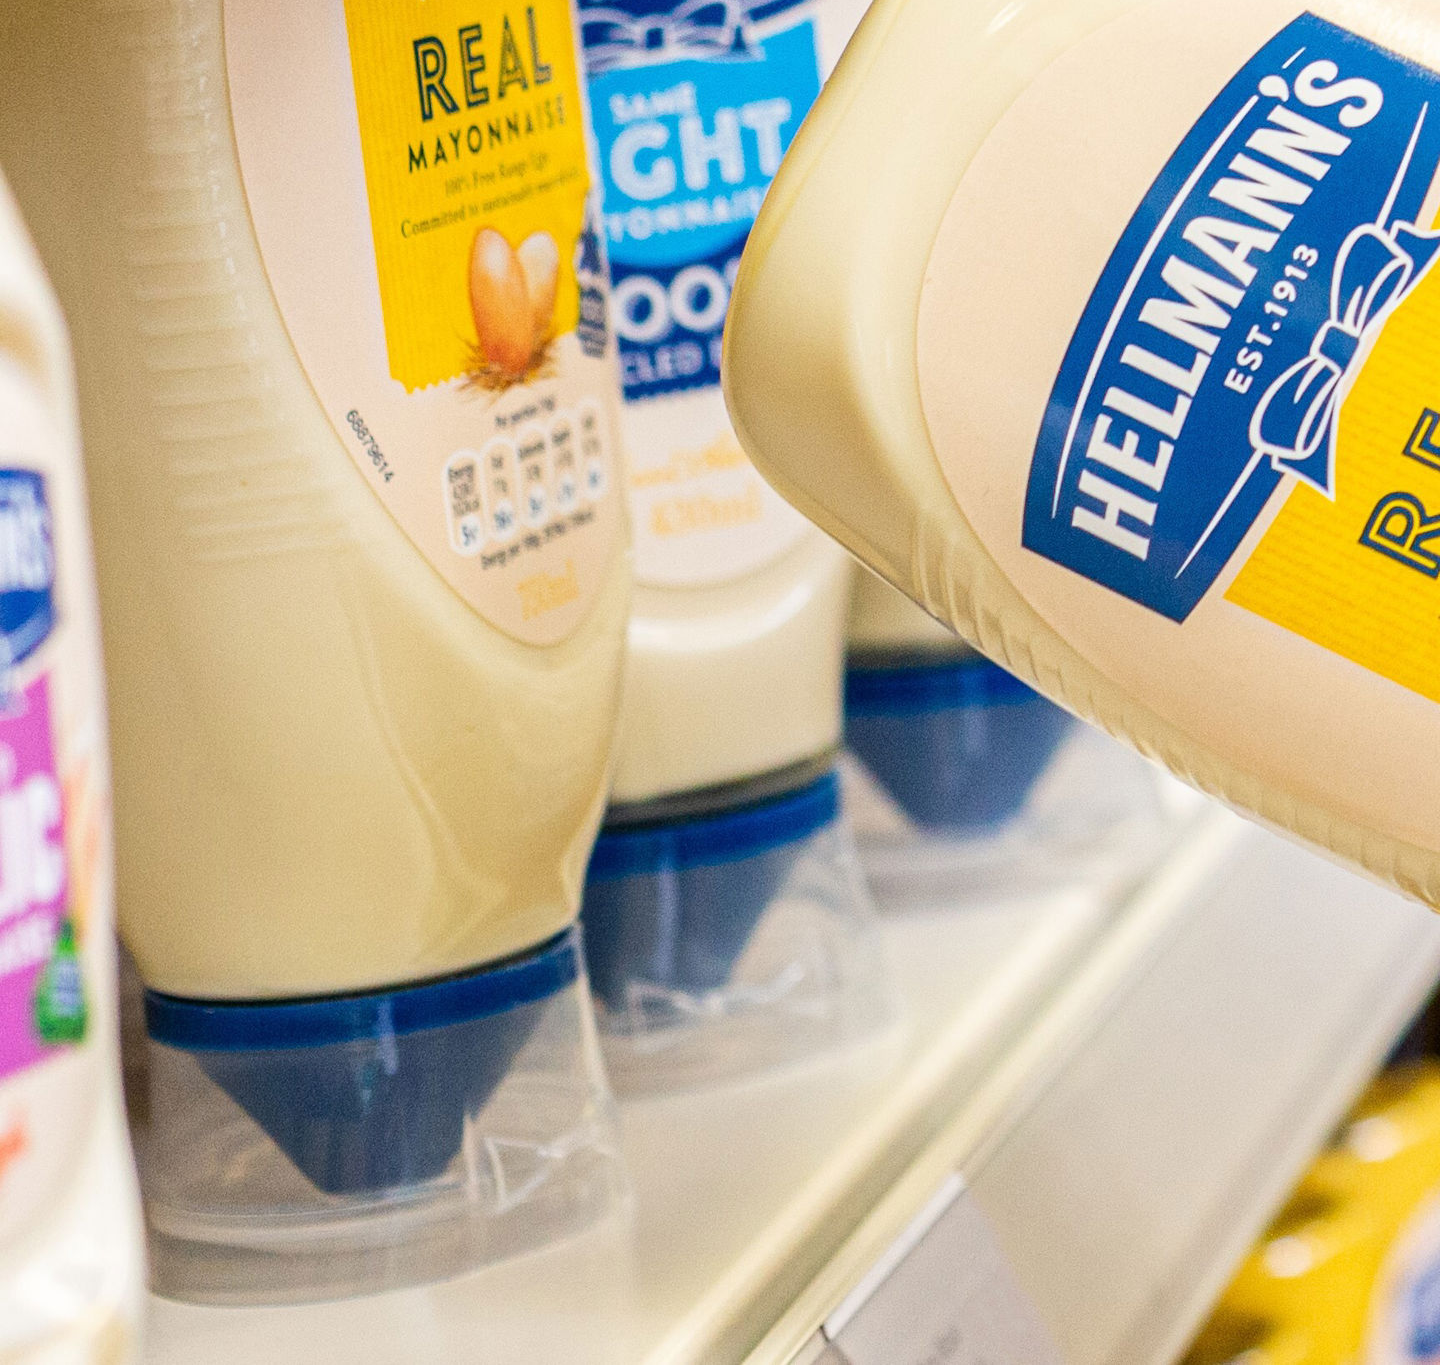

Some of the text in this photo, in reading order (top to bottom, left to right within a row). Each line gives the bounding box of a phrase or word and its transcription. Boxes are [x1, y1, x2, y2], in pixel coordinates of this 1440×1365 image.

[413, 6, 552, 122] REAL
[408, 94, 566, 174] MAYONNAISE
[609, 97, 792, 201] GHT
[1071, 58, 1385, 562] HELLMANN'S
[1224, 243, 1320, 396] EST.1913
